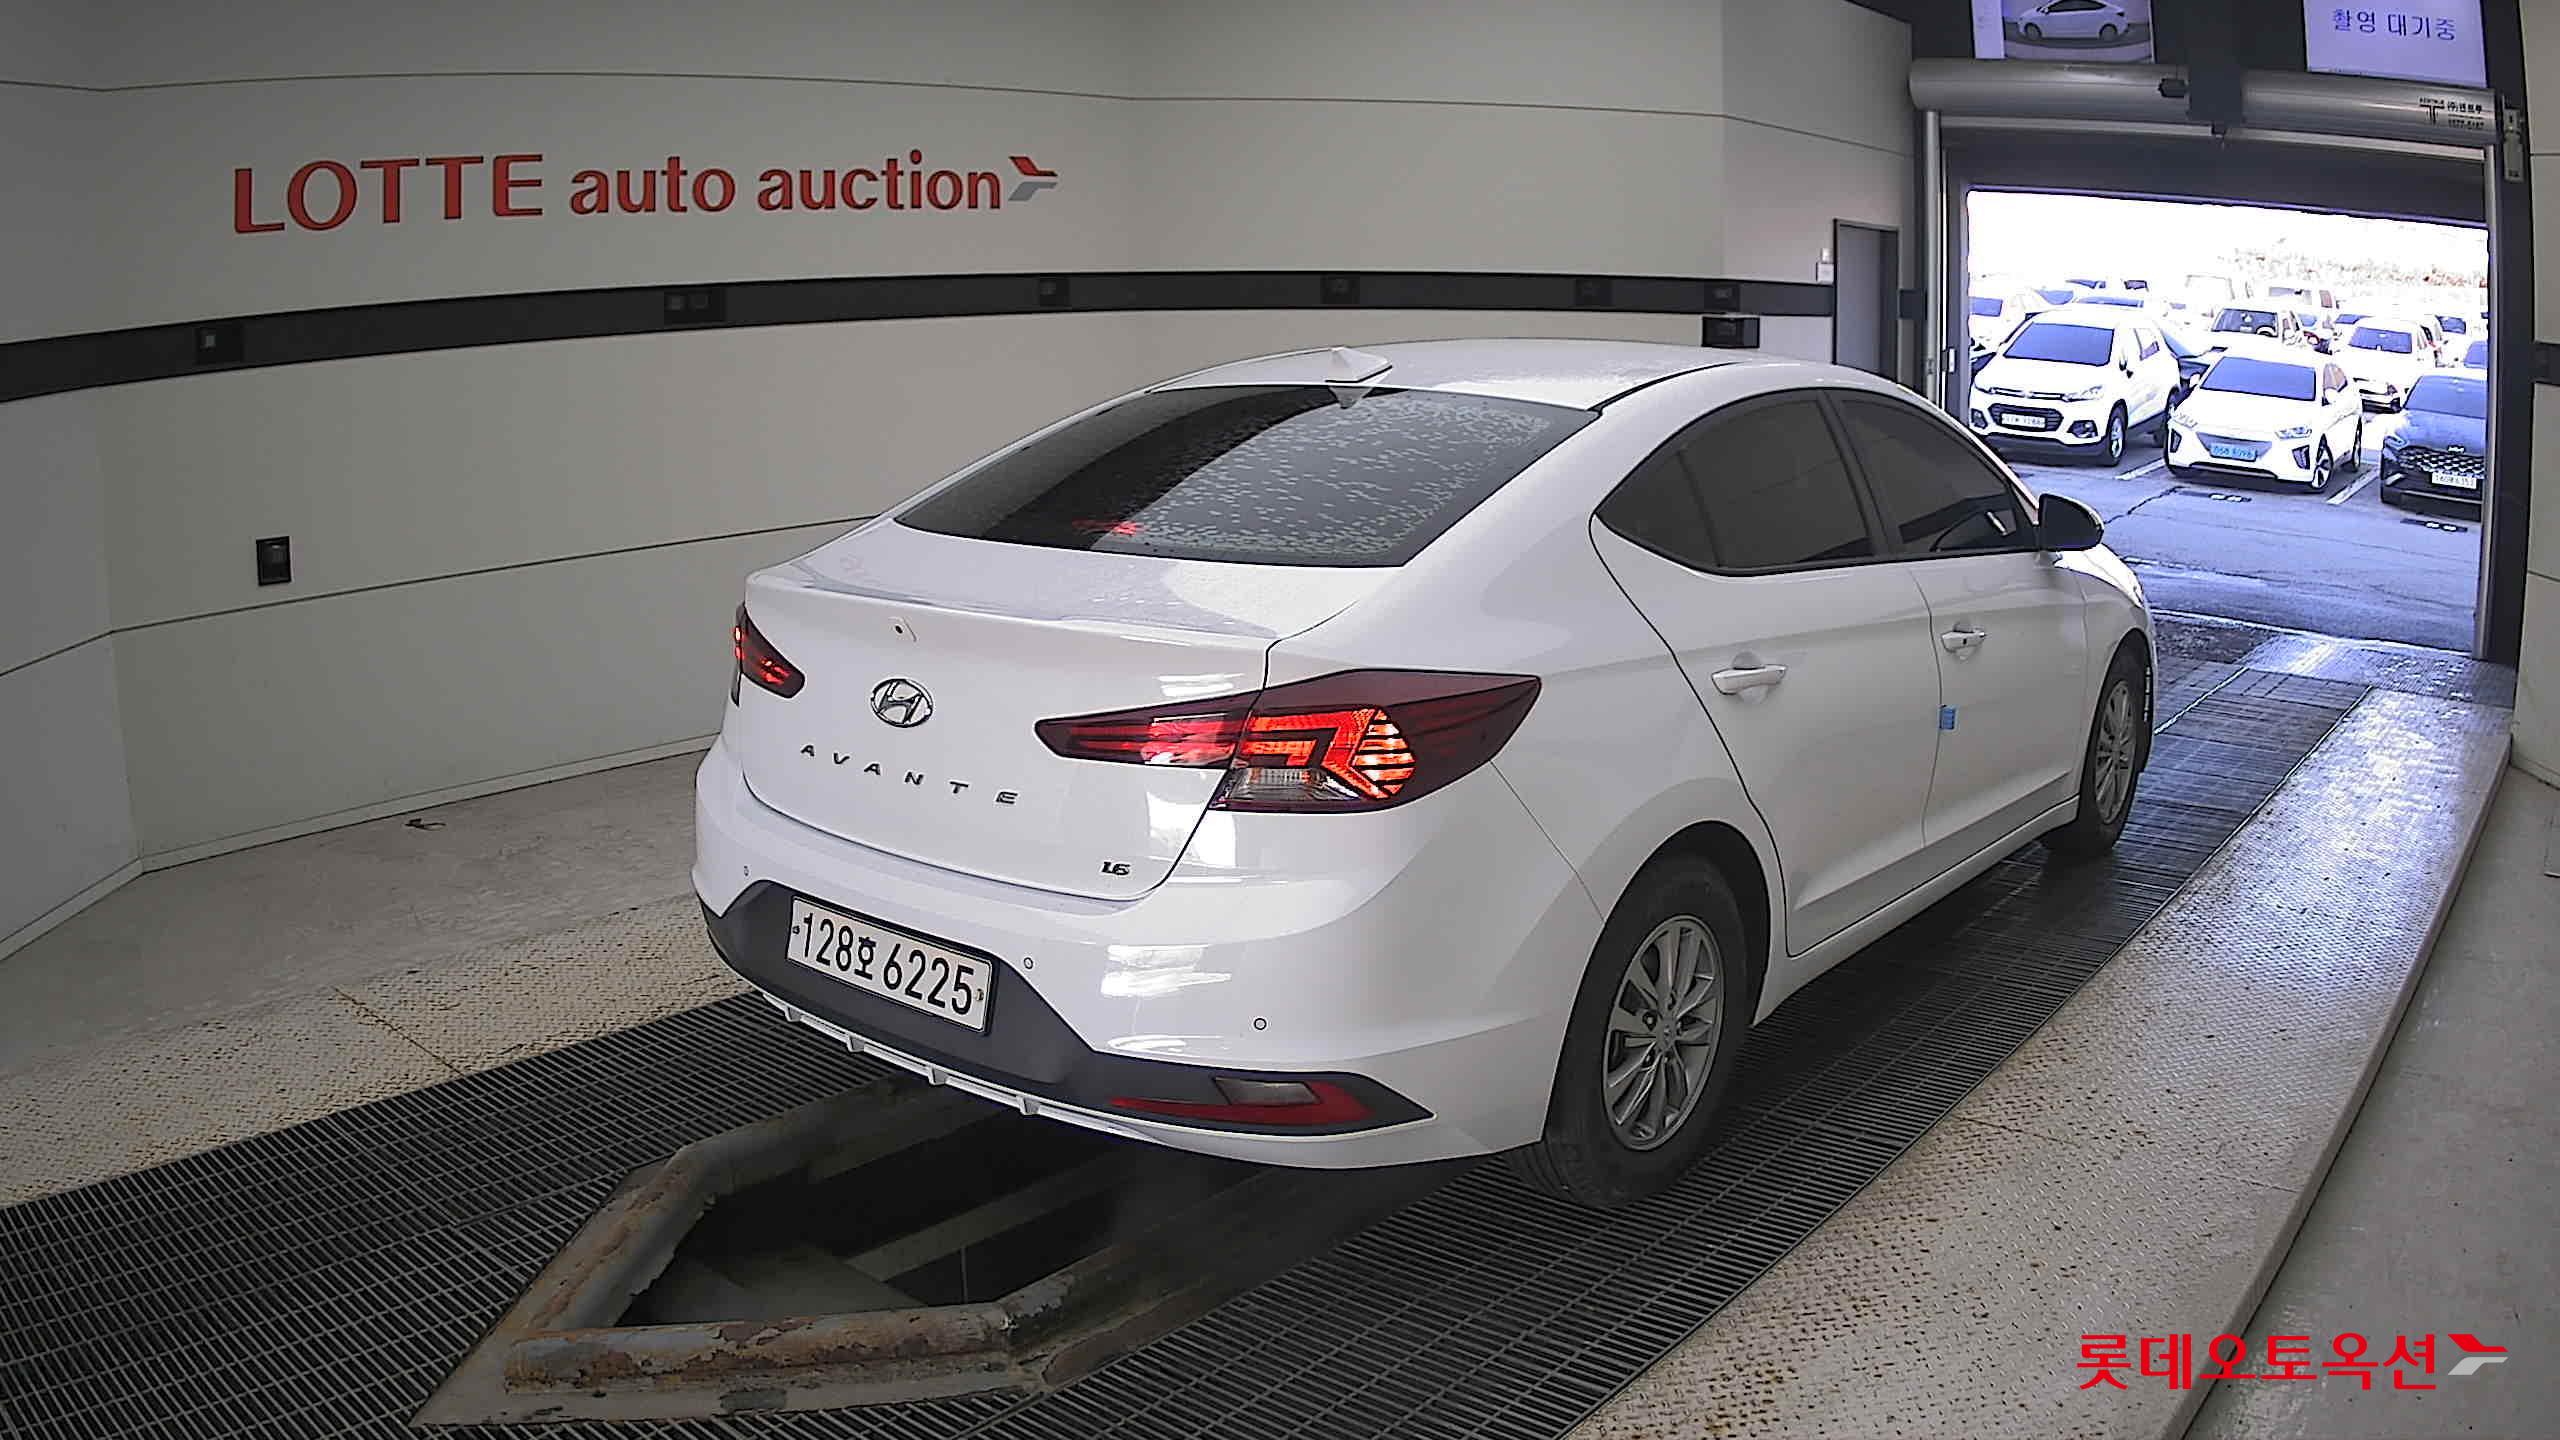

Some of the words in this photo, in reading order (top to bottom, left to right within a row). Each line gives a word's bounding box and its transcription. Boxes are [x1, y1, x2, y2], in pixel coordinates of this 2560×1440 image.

[2332, 9, 2376, 34] 촬영
[2387, 14, 2456, 41] 대기중
[235, 154, 541, 234] LOTTE
[571, 158, 738, 214] auto
[760, 149, 1003, 211] auction
[800, 743, 1020, 807] AVANTE
